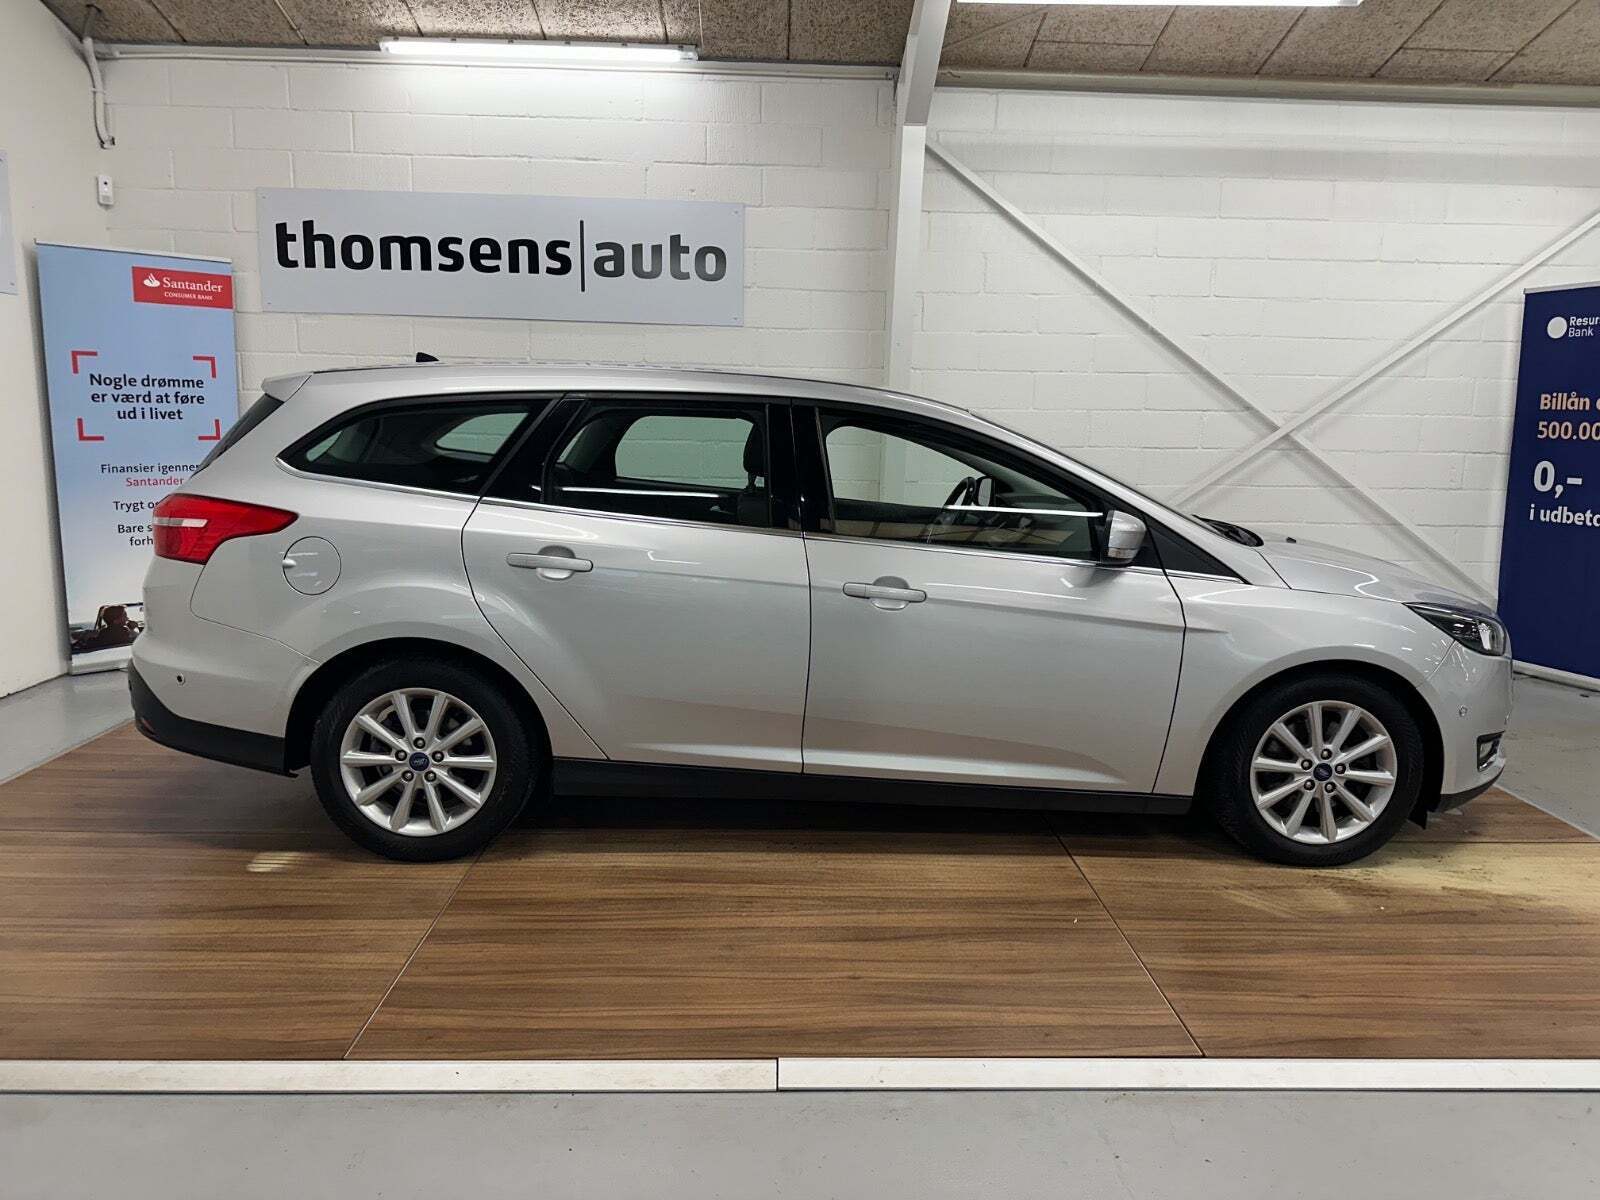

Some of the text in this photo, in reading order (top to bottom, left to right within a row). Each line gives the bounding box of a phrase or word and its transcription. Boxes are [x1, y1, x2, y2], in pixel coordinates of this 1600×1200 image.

[162, 276, 223, 293] Santander
[164, 291, 197, 299] CONSUMER
[1569, 316, 1600, 326] Resur
[1568, 327, 1594, 337] Bank
[89, 373, 204, 390] Nogle drømme
[91, 391, 205, 405] er værd at føre
[1540, 391, 1591, 411] Billån
[117, 407, 184, 420] ud i livet
[1537, 421, 1600, 440] 500.00
[101, 463, 154, 474] Finansier
[126, 476, 184, 487] Santander
[1533, 460, 1583, 499] 0,-
[113, 501, 145, 512] Trygt
[1529, 503, 1535, 521] i
[118, 524, 144, 533] Bare
